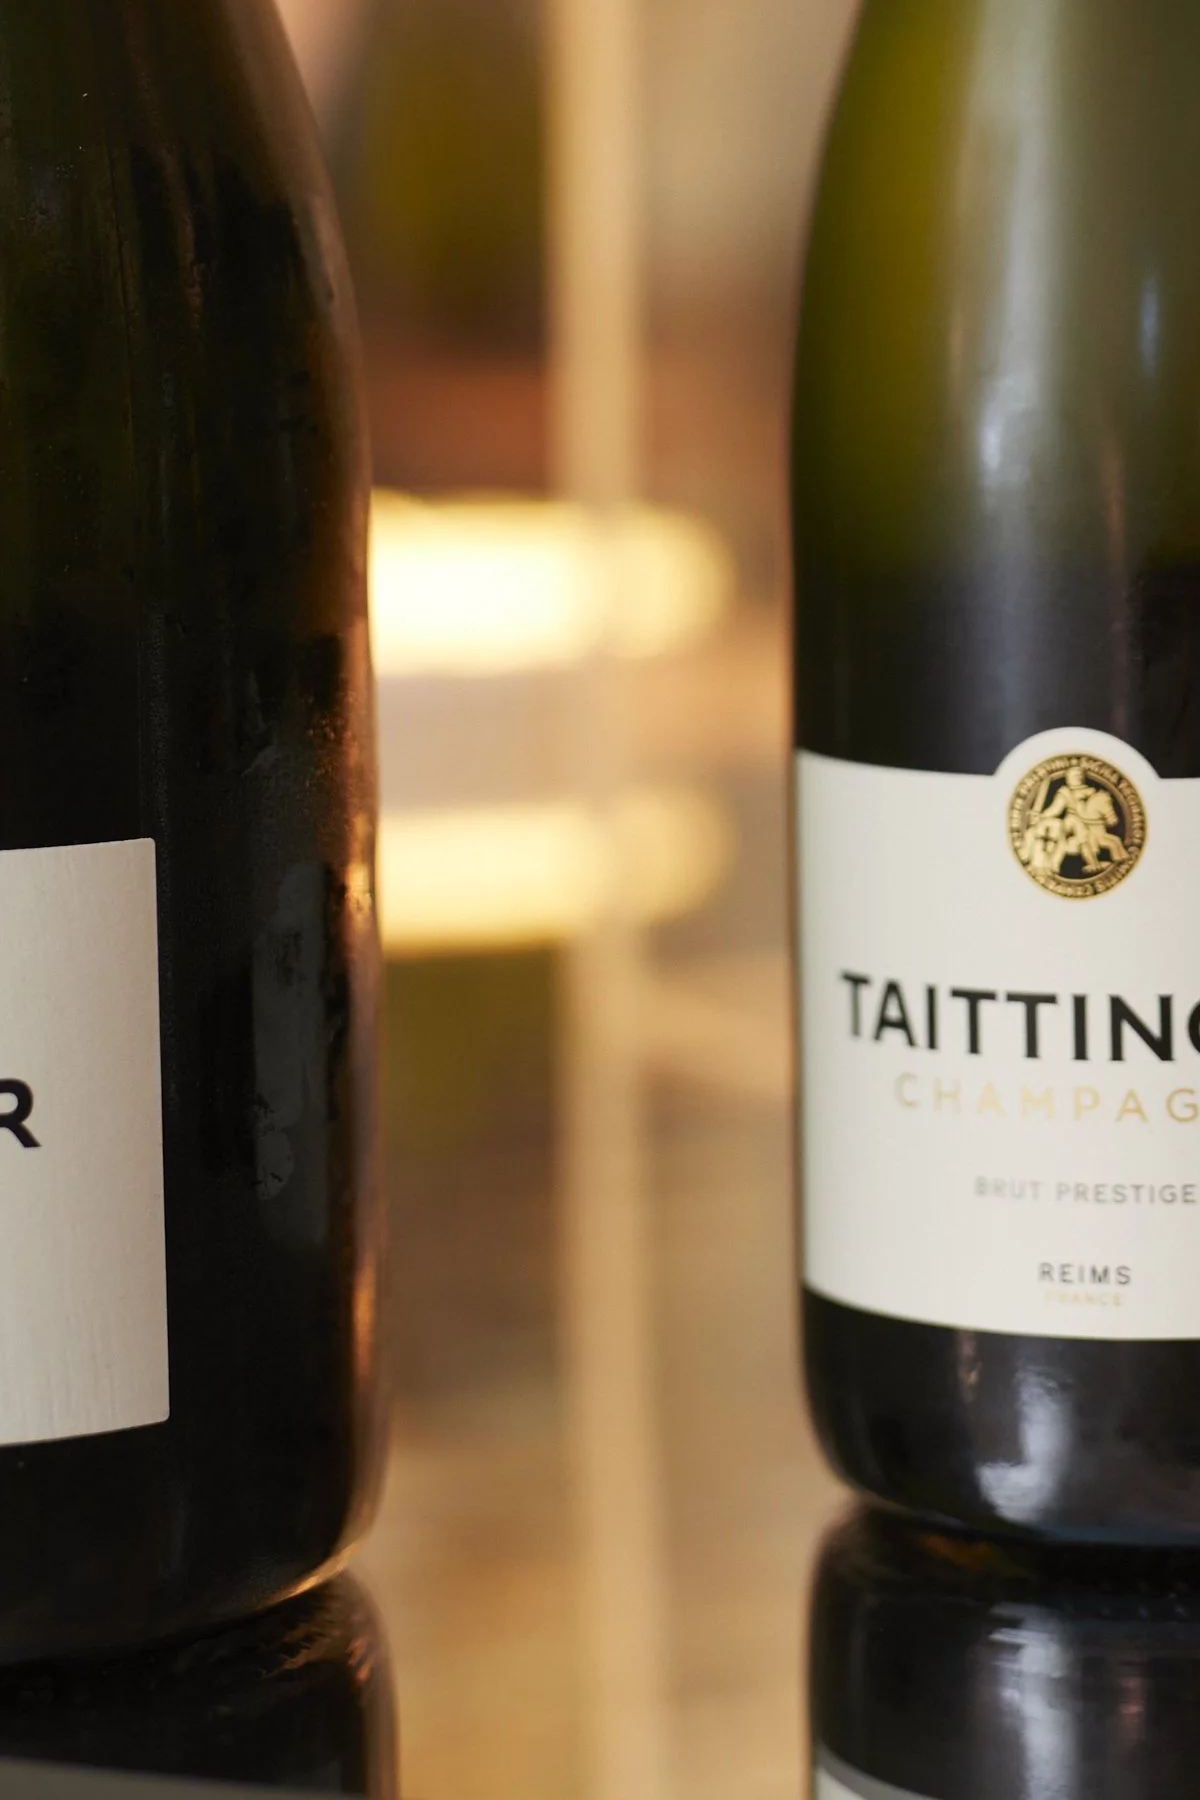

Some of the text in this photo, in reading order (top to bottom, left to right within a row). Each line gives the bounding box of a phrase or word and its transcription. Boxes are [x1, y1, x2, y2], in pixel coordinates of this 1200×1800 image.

[973, 1175, 1198, 1204] BRUT PRESTIGE
[1037, 1261, 1132, 1285] REIMS
